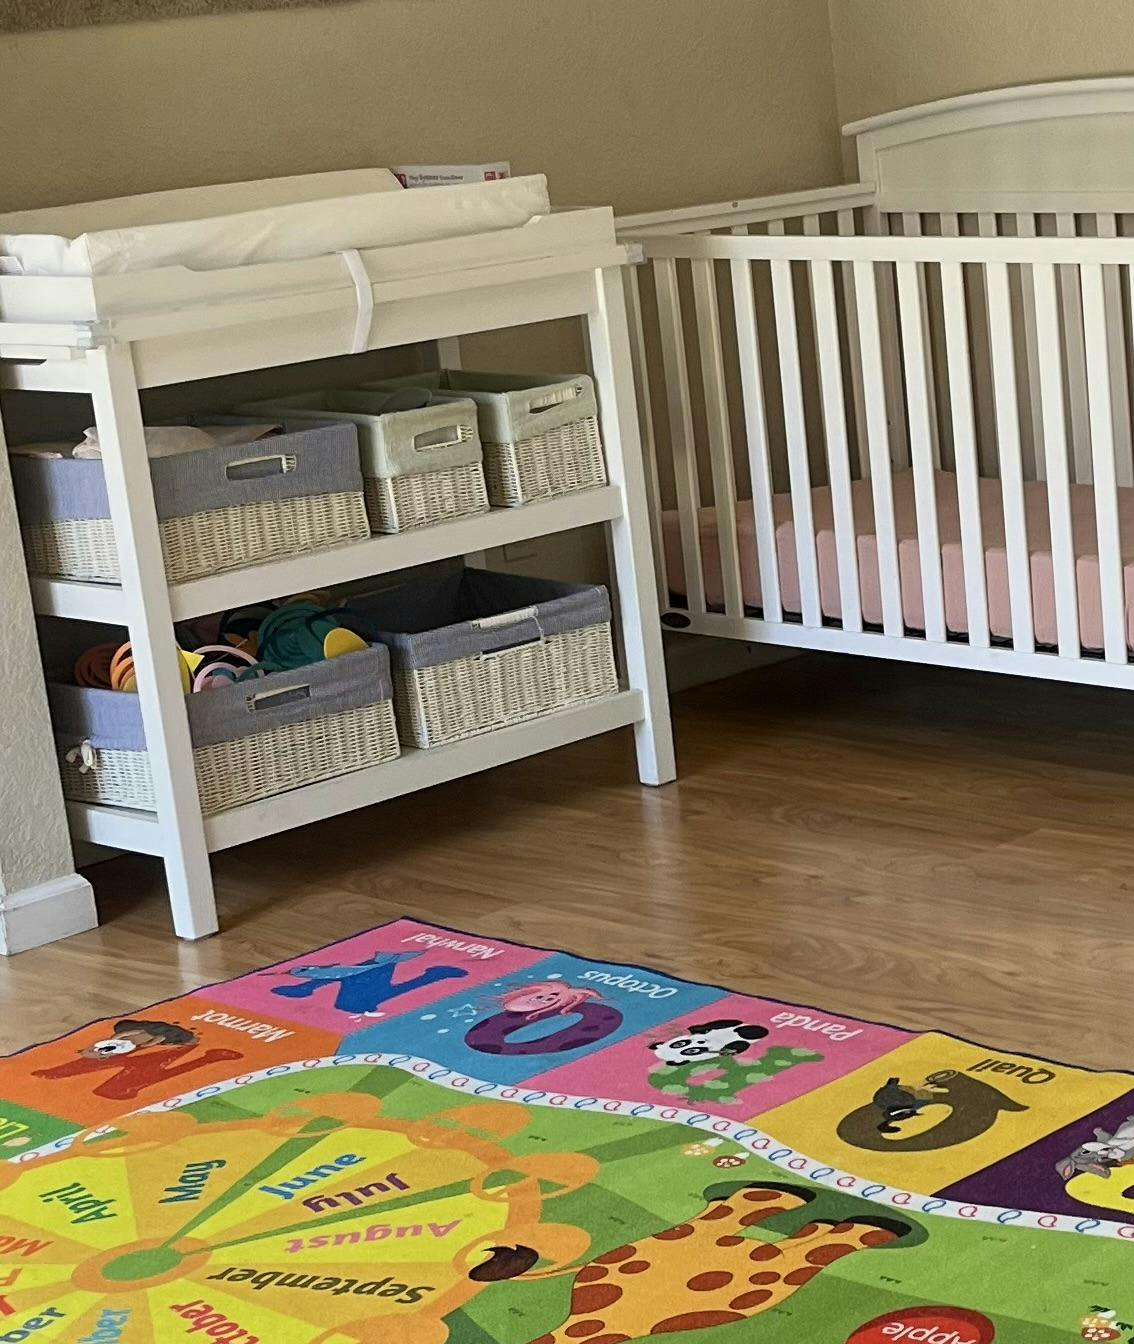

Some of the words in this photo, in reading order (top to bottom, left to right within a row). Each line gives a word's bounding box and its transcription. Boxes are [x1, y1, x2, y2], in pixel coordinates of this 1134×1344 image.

[403, 930, 504, 961] Narwhal
[578, 968, 679, 1000] Octopus
[192, 1009, 294, 1044] Marmot
[770, 1011, 863, 1041] Panda
[967, 1059, 1057, 1087] Quail
[158, 1159, 227, 1204] May
[258, 1151, 367, 1202] June
[301, 1172, 410, 1213] July
[38, 1182, 118, 1224] April
[284, 1218, 463, 1255] August
[206, 1265, 436, 1305] September
